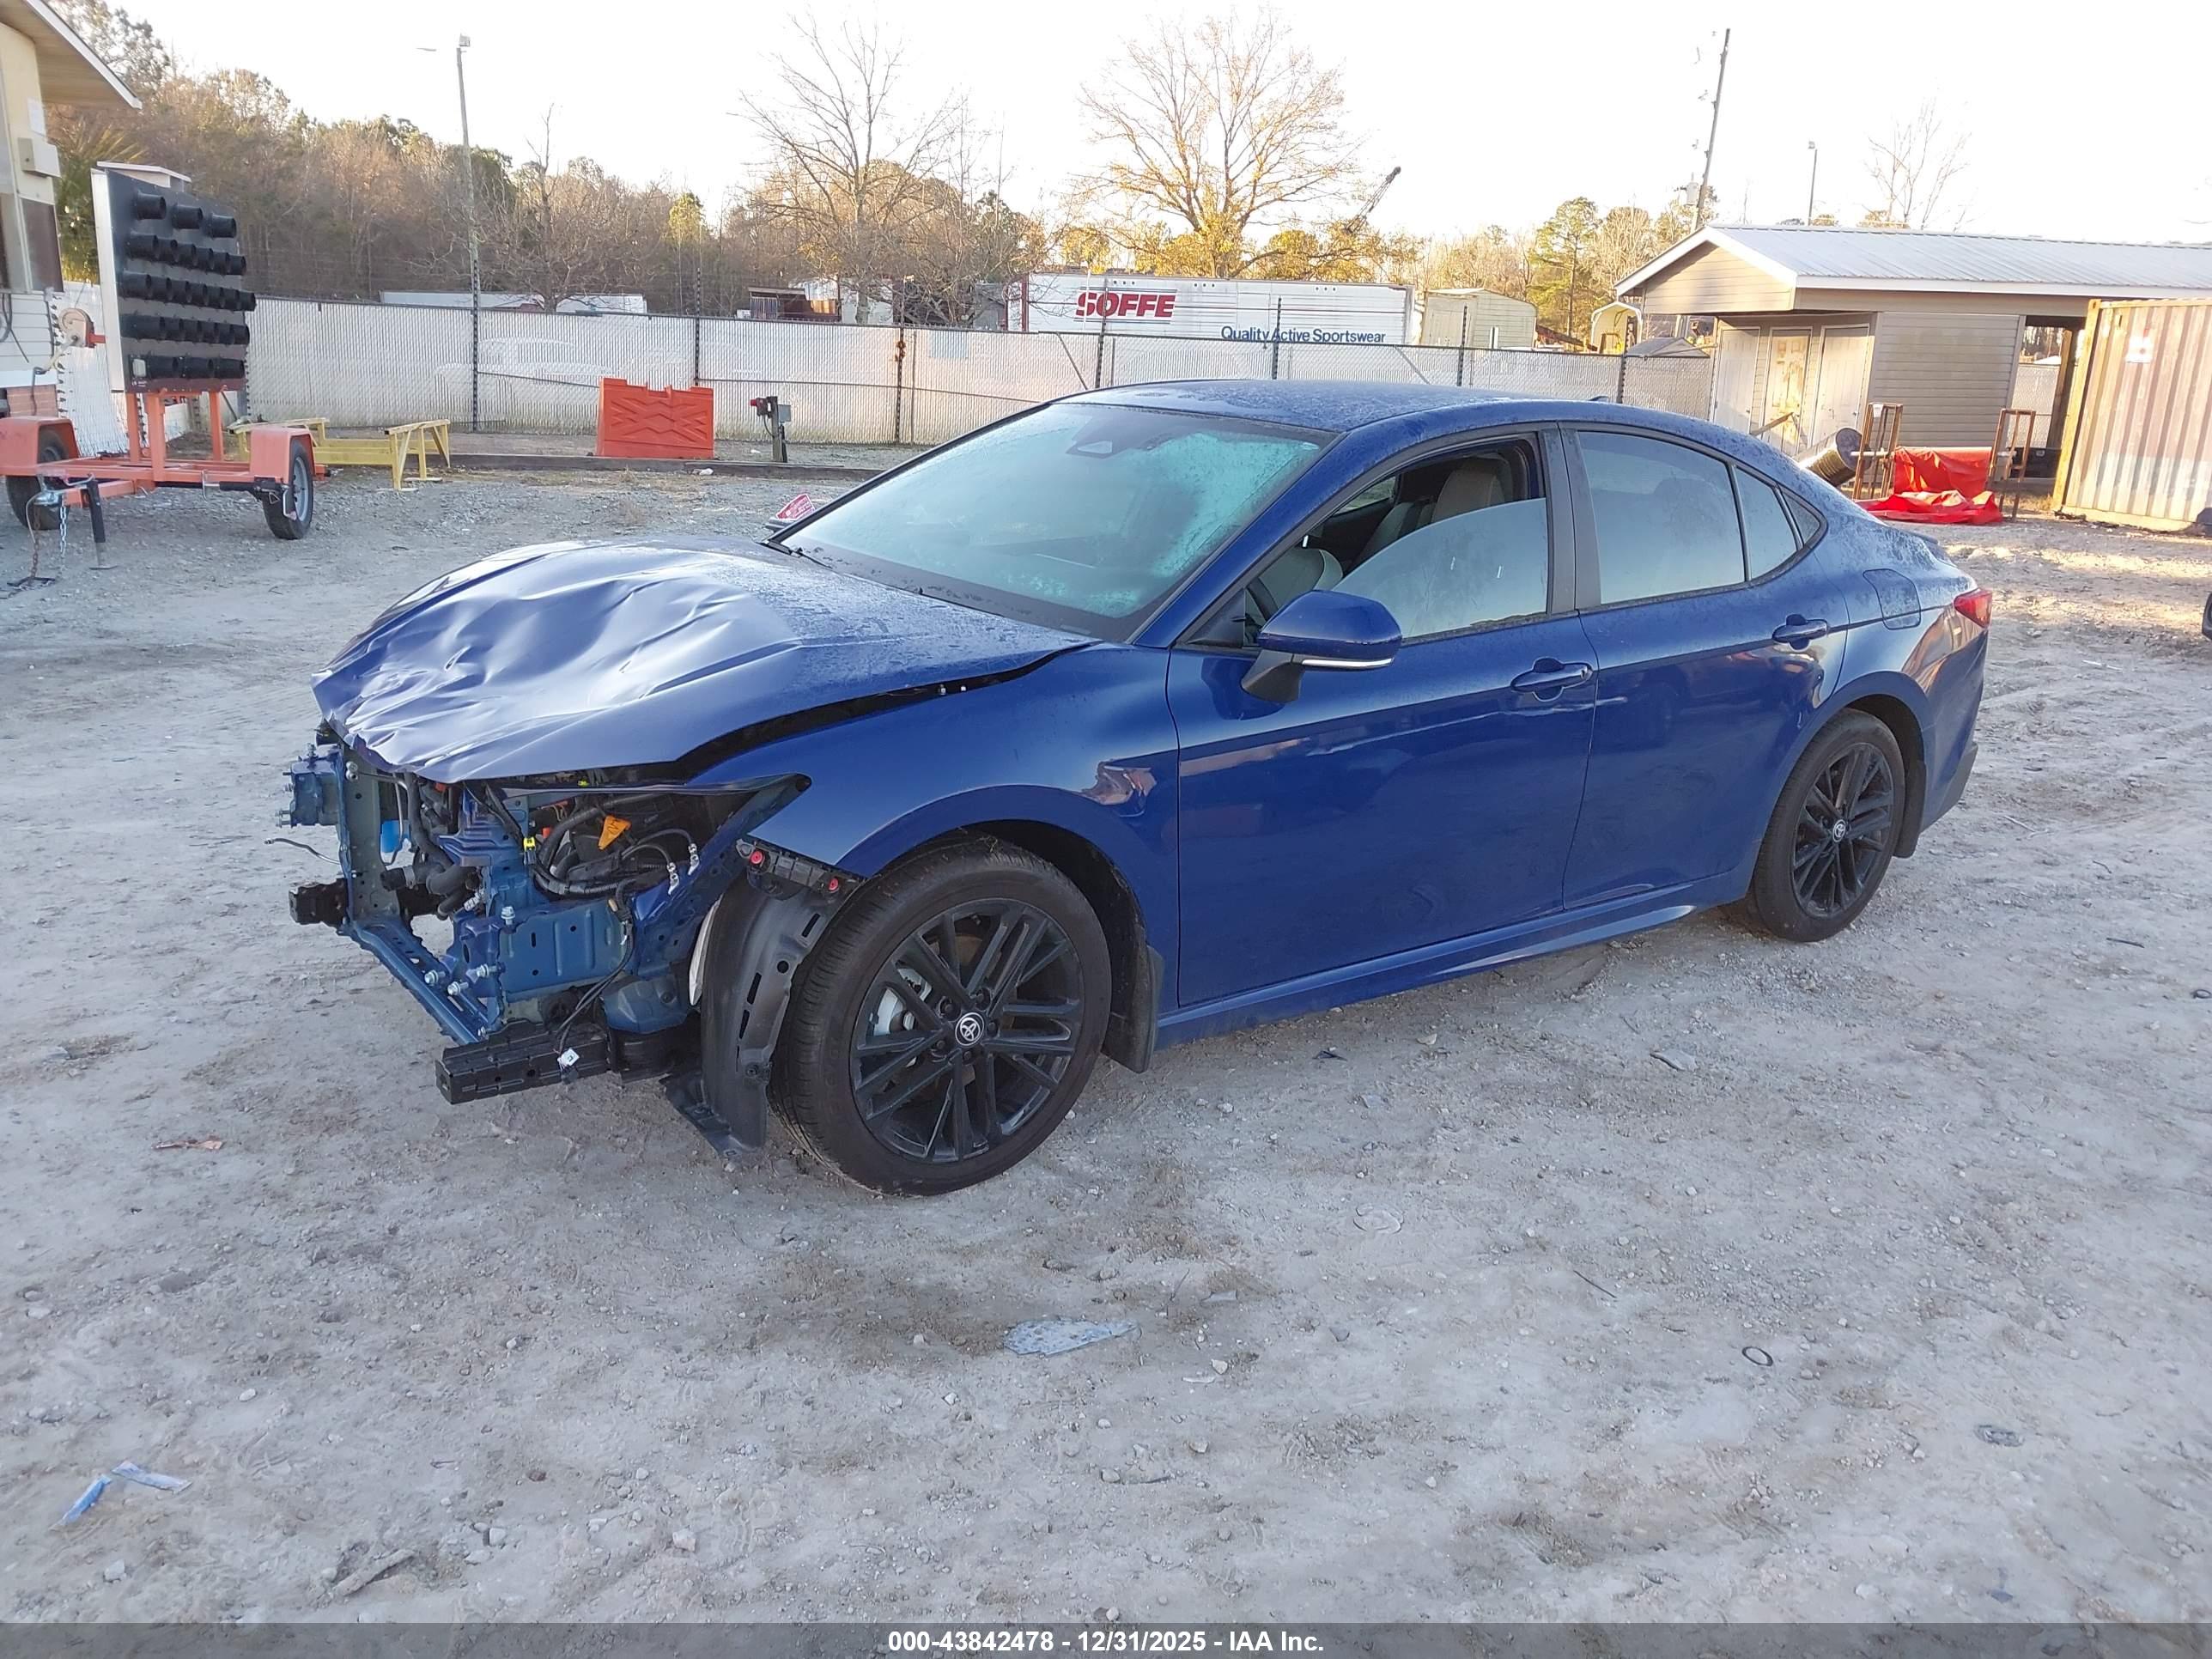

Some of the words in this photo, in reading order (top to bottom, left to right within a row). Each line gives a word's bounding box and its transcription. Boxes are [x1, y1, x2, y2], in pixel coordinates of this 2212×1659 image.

[1075, 292, 1176, 318] SOFFE
[1221, 325, 1270, 343] Quality
[1271, 327, 1310, 343] Active
[1312, 328, 1387, 343] Sportswear
